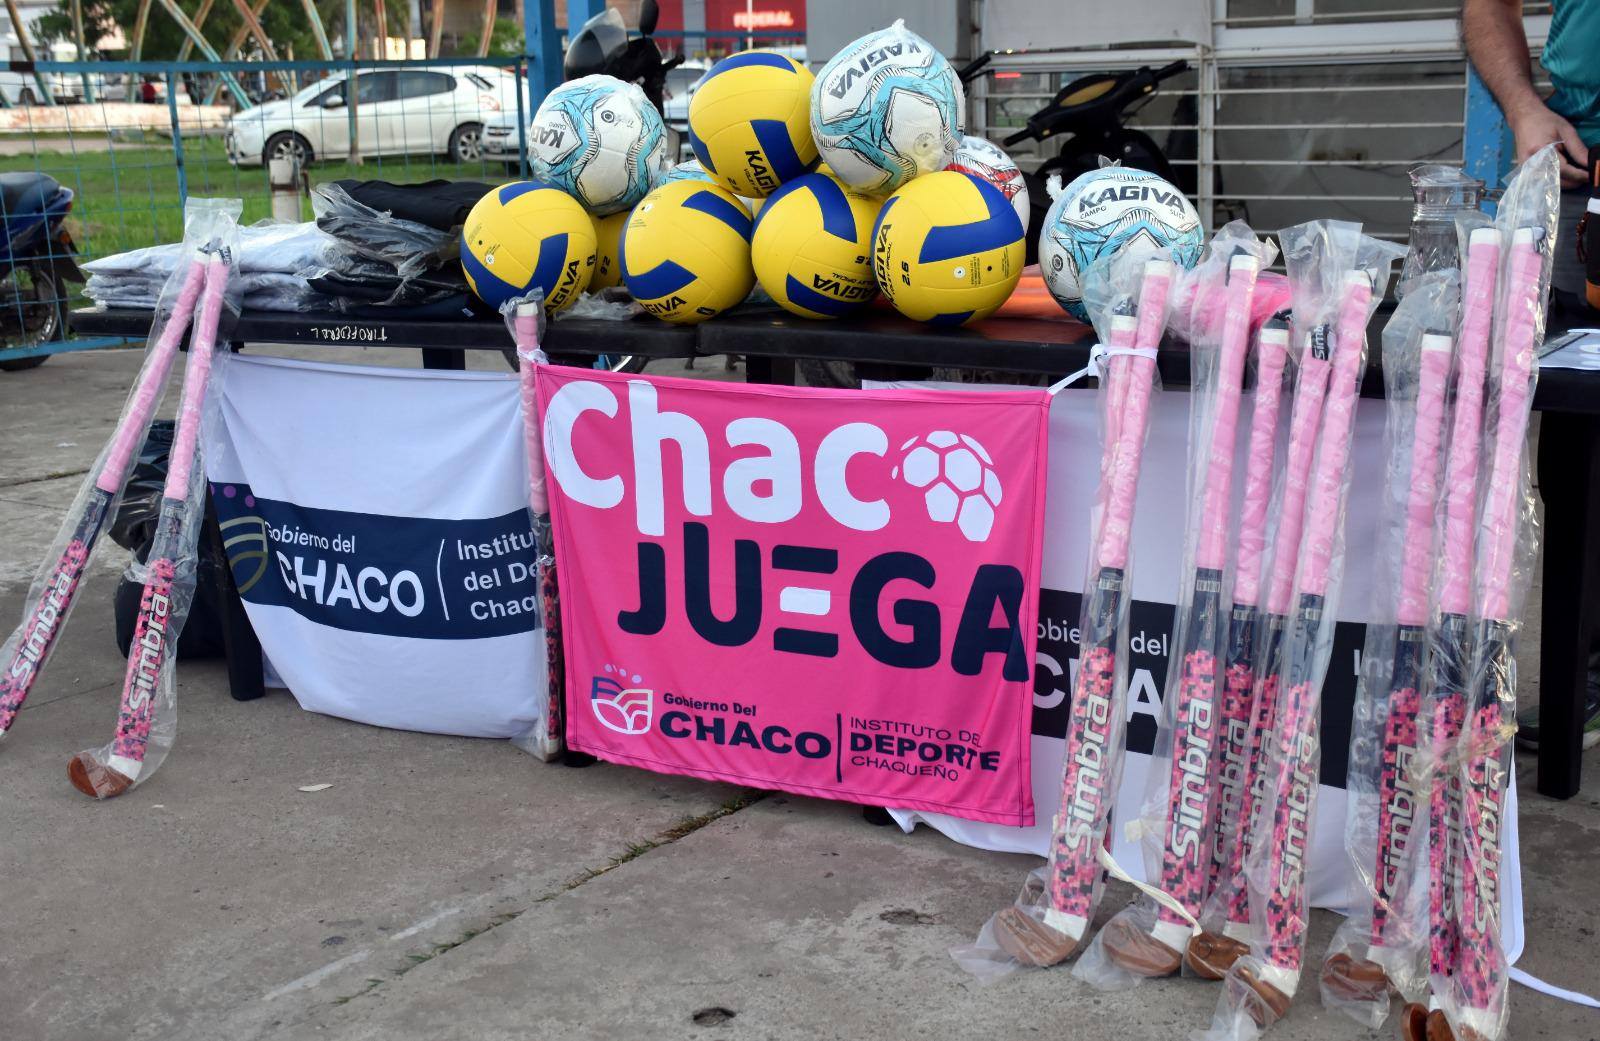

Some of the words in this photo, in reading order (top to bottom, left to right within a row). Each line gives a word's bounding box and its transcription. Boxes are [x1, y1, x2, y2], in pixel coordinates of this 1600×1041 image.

[532, 125, 565, 149] KAG
[745, 149, 777, 194] KAGI
[1078, 185, 1186, 214] KAGIVA
[1080, 205, 1107, 219] CAMPO
[1169, 208, 1185, 220] SLICK
[544, 260, 580, 316] AGIVA
[813, 273, 880, 300] AGIVA
[902, 260, 911, 287] 2.6
[639, 296, 687, 314] GIVA
[332, 534, 356, 554] del
[457, 531, 535, 561] Institu
[275, 549, 425, 617] CHACO
[463, 567, 502, 592] del
[507, 561, 538, 584] De
[470, 595, 536, 620] Chaq
[618, 521, 1030, 682] JUEGA
[11, 571, 72, 688] Simbra
[1036, 617, 1080, 645] obie
[1130, 630, 1168, 657] del
[128, 592, 170, 718] Simbra
[663, 692, 729, 712] Gobierno
[732, 702, 757, 717] Del
[659, 710, 832, 759] CHACO
[850, 716, 952, 741] INSTITUTO
[958, 730, 983, 748] DEL
[850, 732, 1001, 772] DEPORTE
[851, 755, 959, 782] CHAQUEÑO
[1065, 693, 1111, 859] Simbra
[1171, 697, 1213, 867] Simbra
[1279, 731, 1317, 908] Simbra
